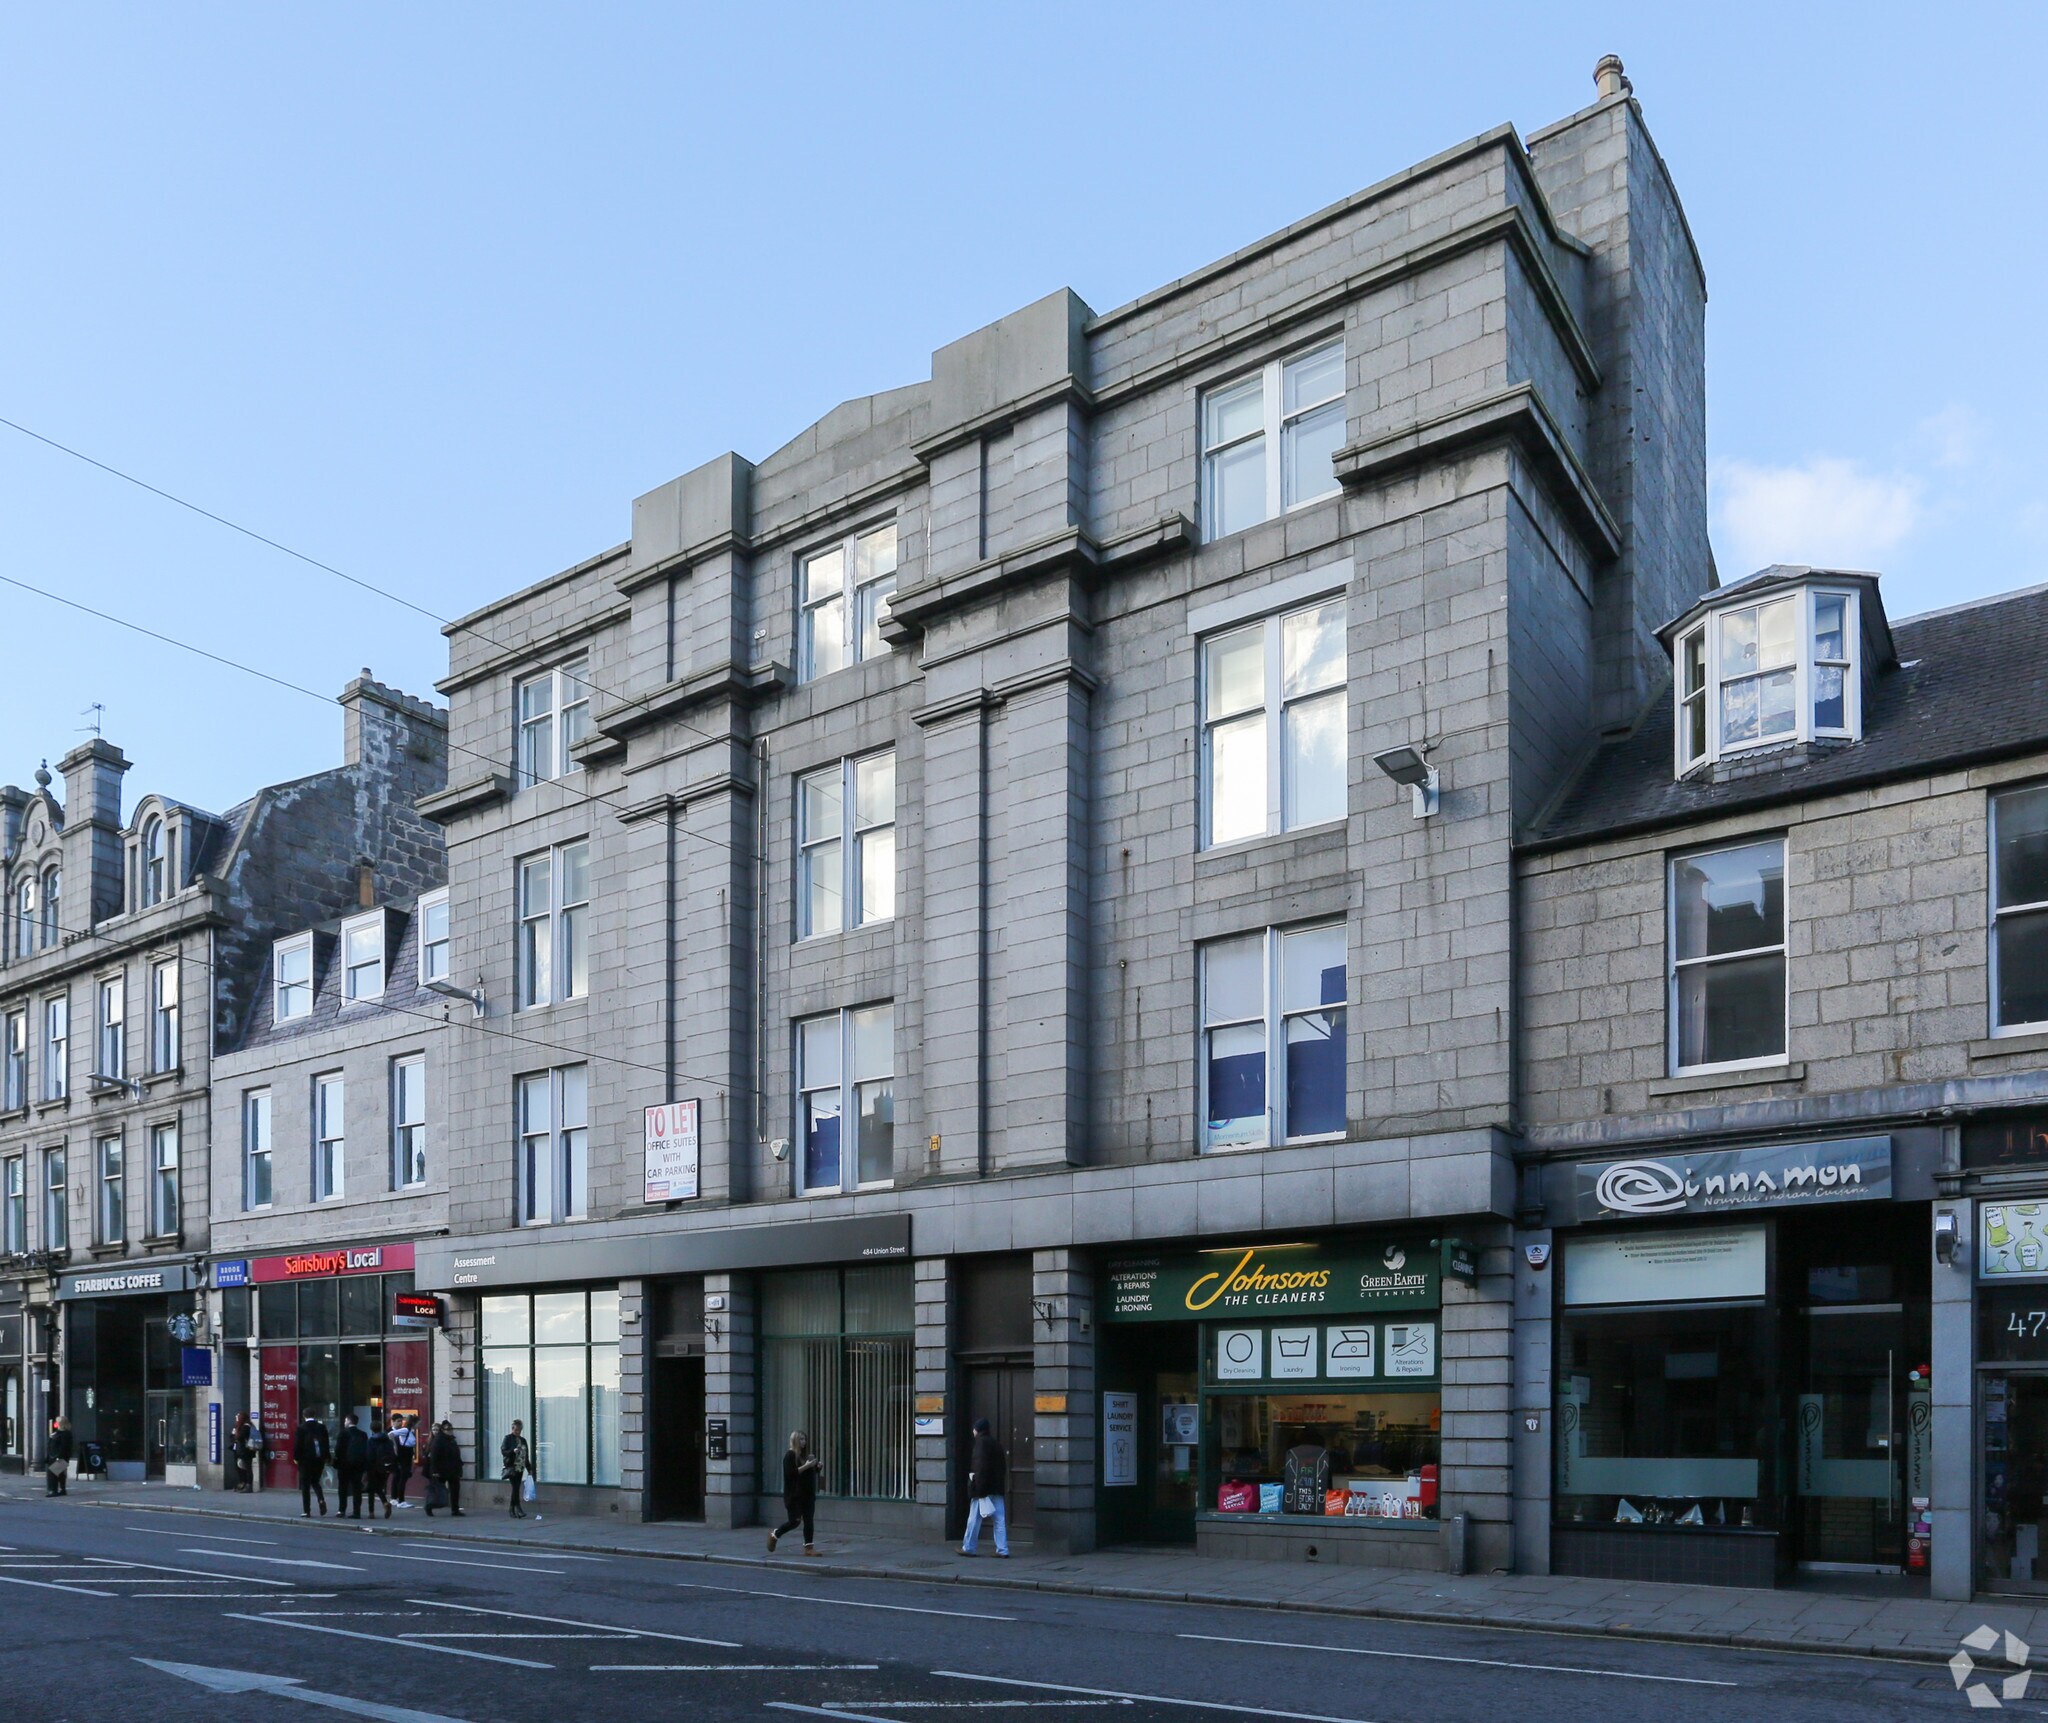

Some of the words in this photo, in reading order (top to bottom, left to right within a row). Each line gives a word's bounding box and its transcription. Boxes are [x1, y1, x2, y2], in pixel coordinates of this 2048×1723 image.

[647, 1107, 665, 1137] TO
[671, 1103, 696, 1134] LET
[647, 1140, 671, 1151] OFFICE
[673, 1136, 696, 1148] SUITES
[662, 1152, 681, 1163] WITH
[647, 1168, 662, 1178] CAR
[665, 1163, 696, 1177] PARKING
[285, 1251, 346, 1274] Sainsbury's
[346, 1247, 380, 1268] Local
[454, 1255, 496, 1268] Assessment
[220, 1265, 241, 1274] BROOK
[218, 1274, 243, 1283] STREET
[454, 1273, 478, 1284] Centre
[1111, 1272, 1157, 1281] ALTERATIONS
[1185, 1250, 1331, 1311] Johnsons
[74, 1276, 126, 1293] STARBUCKS
[126, 1273, 162, 1290] COFFEE
[1123, 1281, 1151, 1290] REPAIRS
[1117, 1295, 1150, 1303] LAUNDRY
[1225, 1294, 1249, 1306] THE
[1256, 1291, 1326, 1304] CLEANERS
[1360, 1290, 1426, 1298] CLEANING
[415, 1305, 436, 1315] Local
[1121, 1304, 1153, 1312] IRONING
[2007, 1311, 2048, 1337] 47
[288, 1373, 297, 1381] day
[394, 1376, 406, 1384] Free
[407, 1376, 420, 1384] cash
[1109, 1424, 1132, 1432] SERVICE
